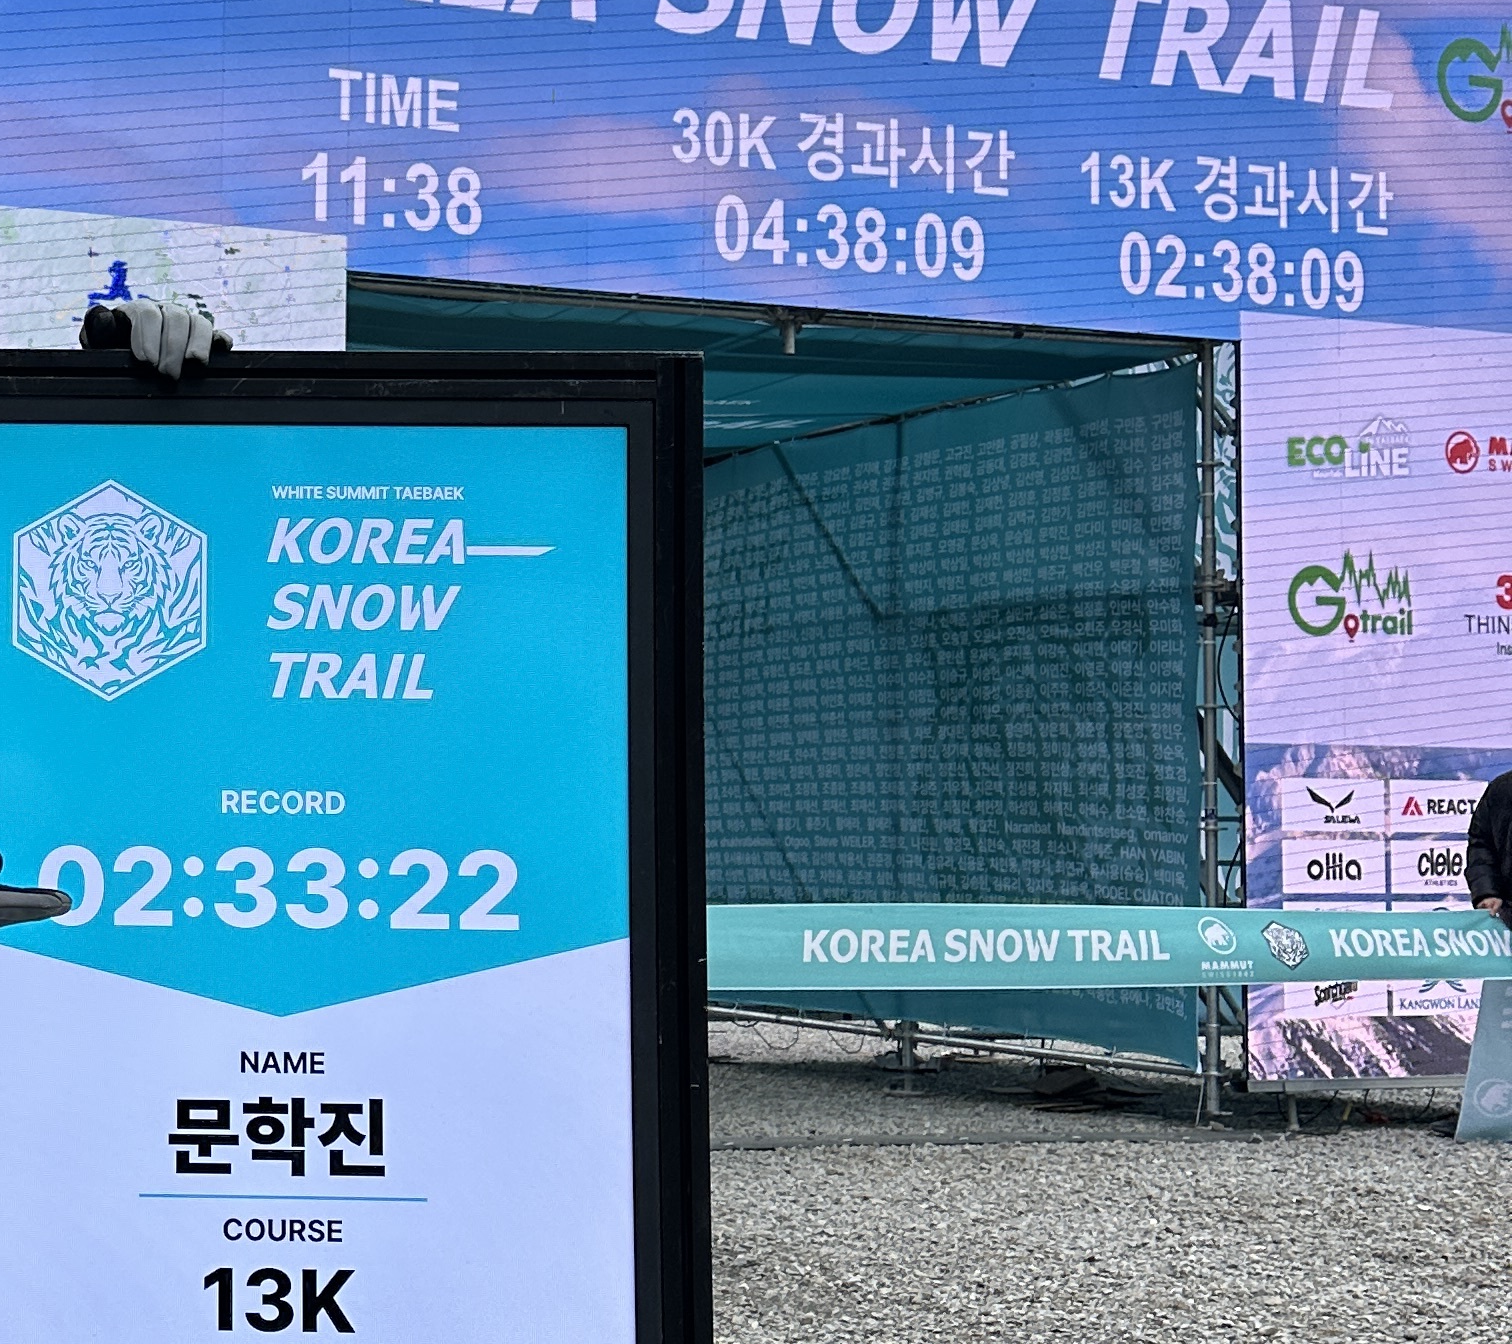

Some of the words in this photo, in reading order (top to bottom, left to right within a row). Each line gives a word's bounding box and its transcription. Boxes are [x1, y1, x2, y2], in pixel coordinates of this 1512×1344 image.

[329, 69, 460, 133] TIME
[672, 107, 778, 171] 30K
[797, 113, 1015, 198] 경과시간
[302, 152, 483, 237] 11:38
[1081, 150, 1177, 214] 13K
[1194, 155, 1394, 239] 경과시간
[714, 194, 986, 282] 04:38:09
[1119, 230, 1366, 313] 02:38:09
[1286, 435, 1347, 467] ECO
[272, 486, 323, 500] WHITE
[326, 486, 389, 501] SUMMIT
[393, 487, 464, 501] TAEBAEK
[267, 518, 466, 565] KOREA
[267, 584, 462, 632] SNOW
[1464, 614, 1512, 634] THIN
[1149, 638, 1187, 658] 이리나,
[268, 653, 435, 700] TRAIL
[1110, 659, 1146, 678] 이영신,
[1149, 680, 1185, 700] 이지연,
[221, 790, 346, 815] RECORD
[1004, 819, 1052, 835] Naranbat
[1120, 846, 1147, 861] HAN
[1150, 847, 1188, 870] YABIN,
[37, 844, 521, 931] 02:33:22
[802, 927, 936, 964] KOREA
[944, 927, 1060, 963] SNOW
[1067, 928, 1171, 962] TRAIL
[1329, 928, 1432, 957] KOREA
[1433, 928, 1512, 957] SNOW
[1202, 961, 1254, 971] MAMMUT
[1399, 997, 1455, 1011] KANGWON
[1457, 997, 1481, 1010] LAN
[239, 1051, 325, 1075] NAME
[168, 1097, 386, 1177] 문학진
[223, 1218, 343, 1243] COURSE
[202, 1267, 356, 1334] 13K
